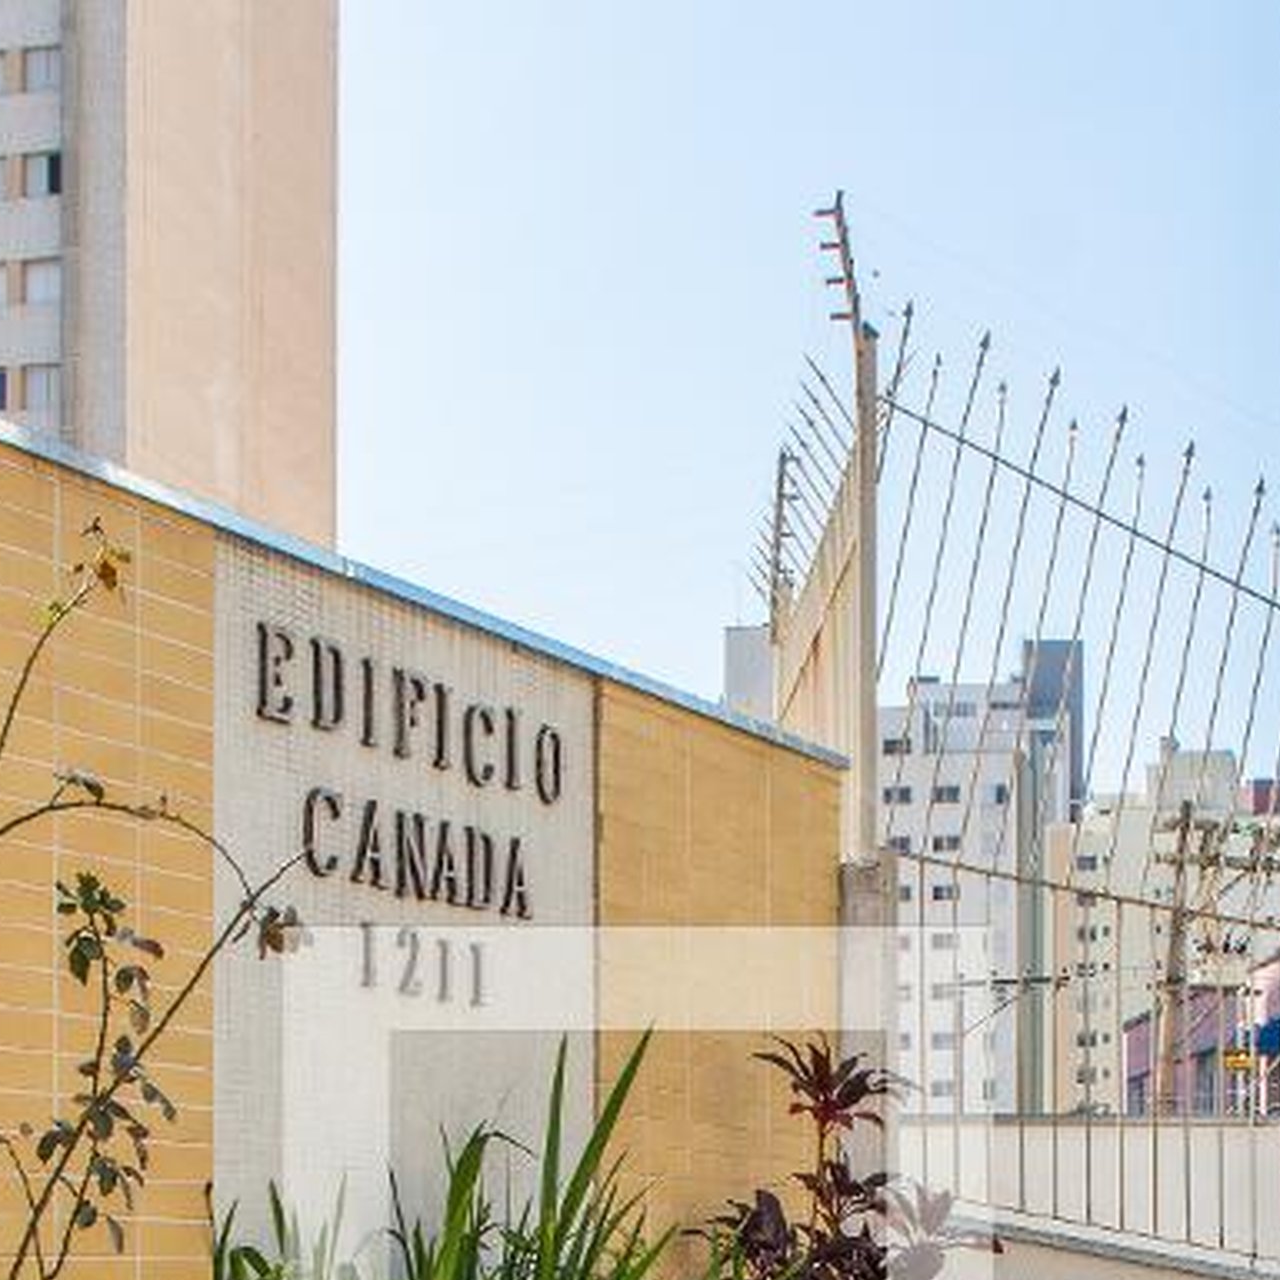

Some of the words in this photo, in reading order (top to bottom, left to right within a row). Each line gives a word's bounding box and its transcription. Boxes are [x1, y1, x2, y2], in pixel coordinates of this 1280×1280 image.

[256, 621, 562, 806] EDIFICIO
[302, 786, 534, 921] CANADA
[359, 921, 487, 1007] 1211
